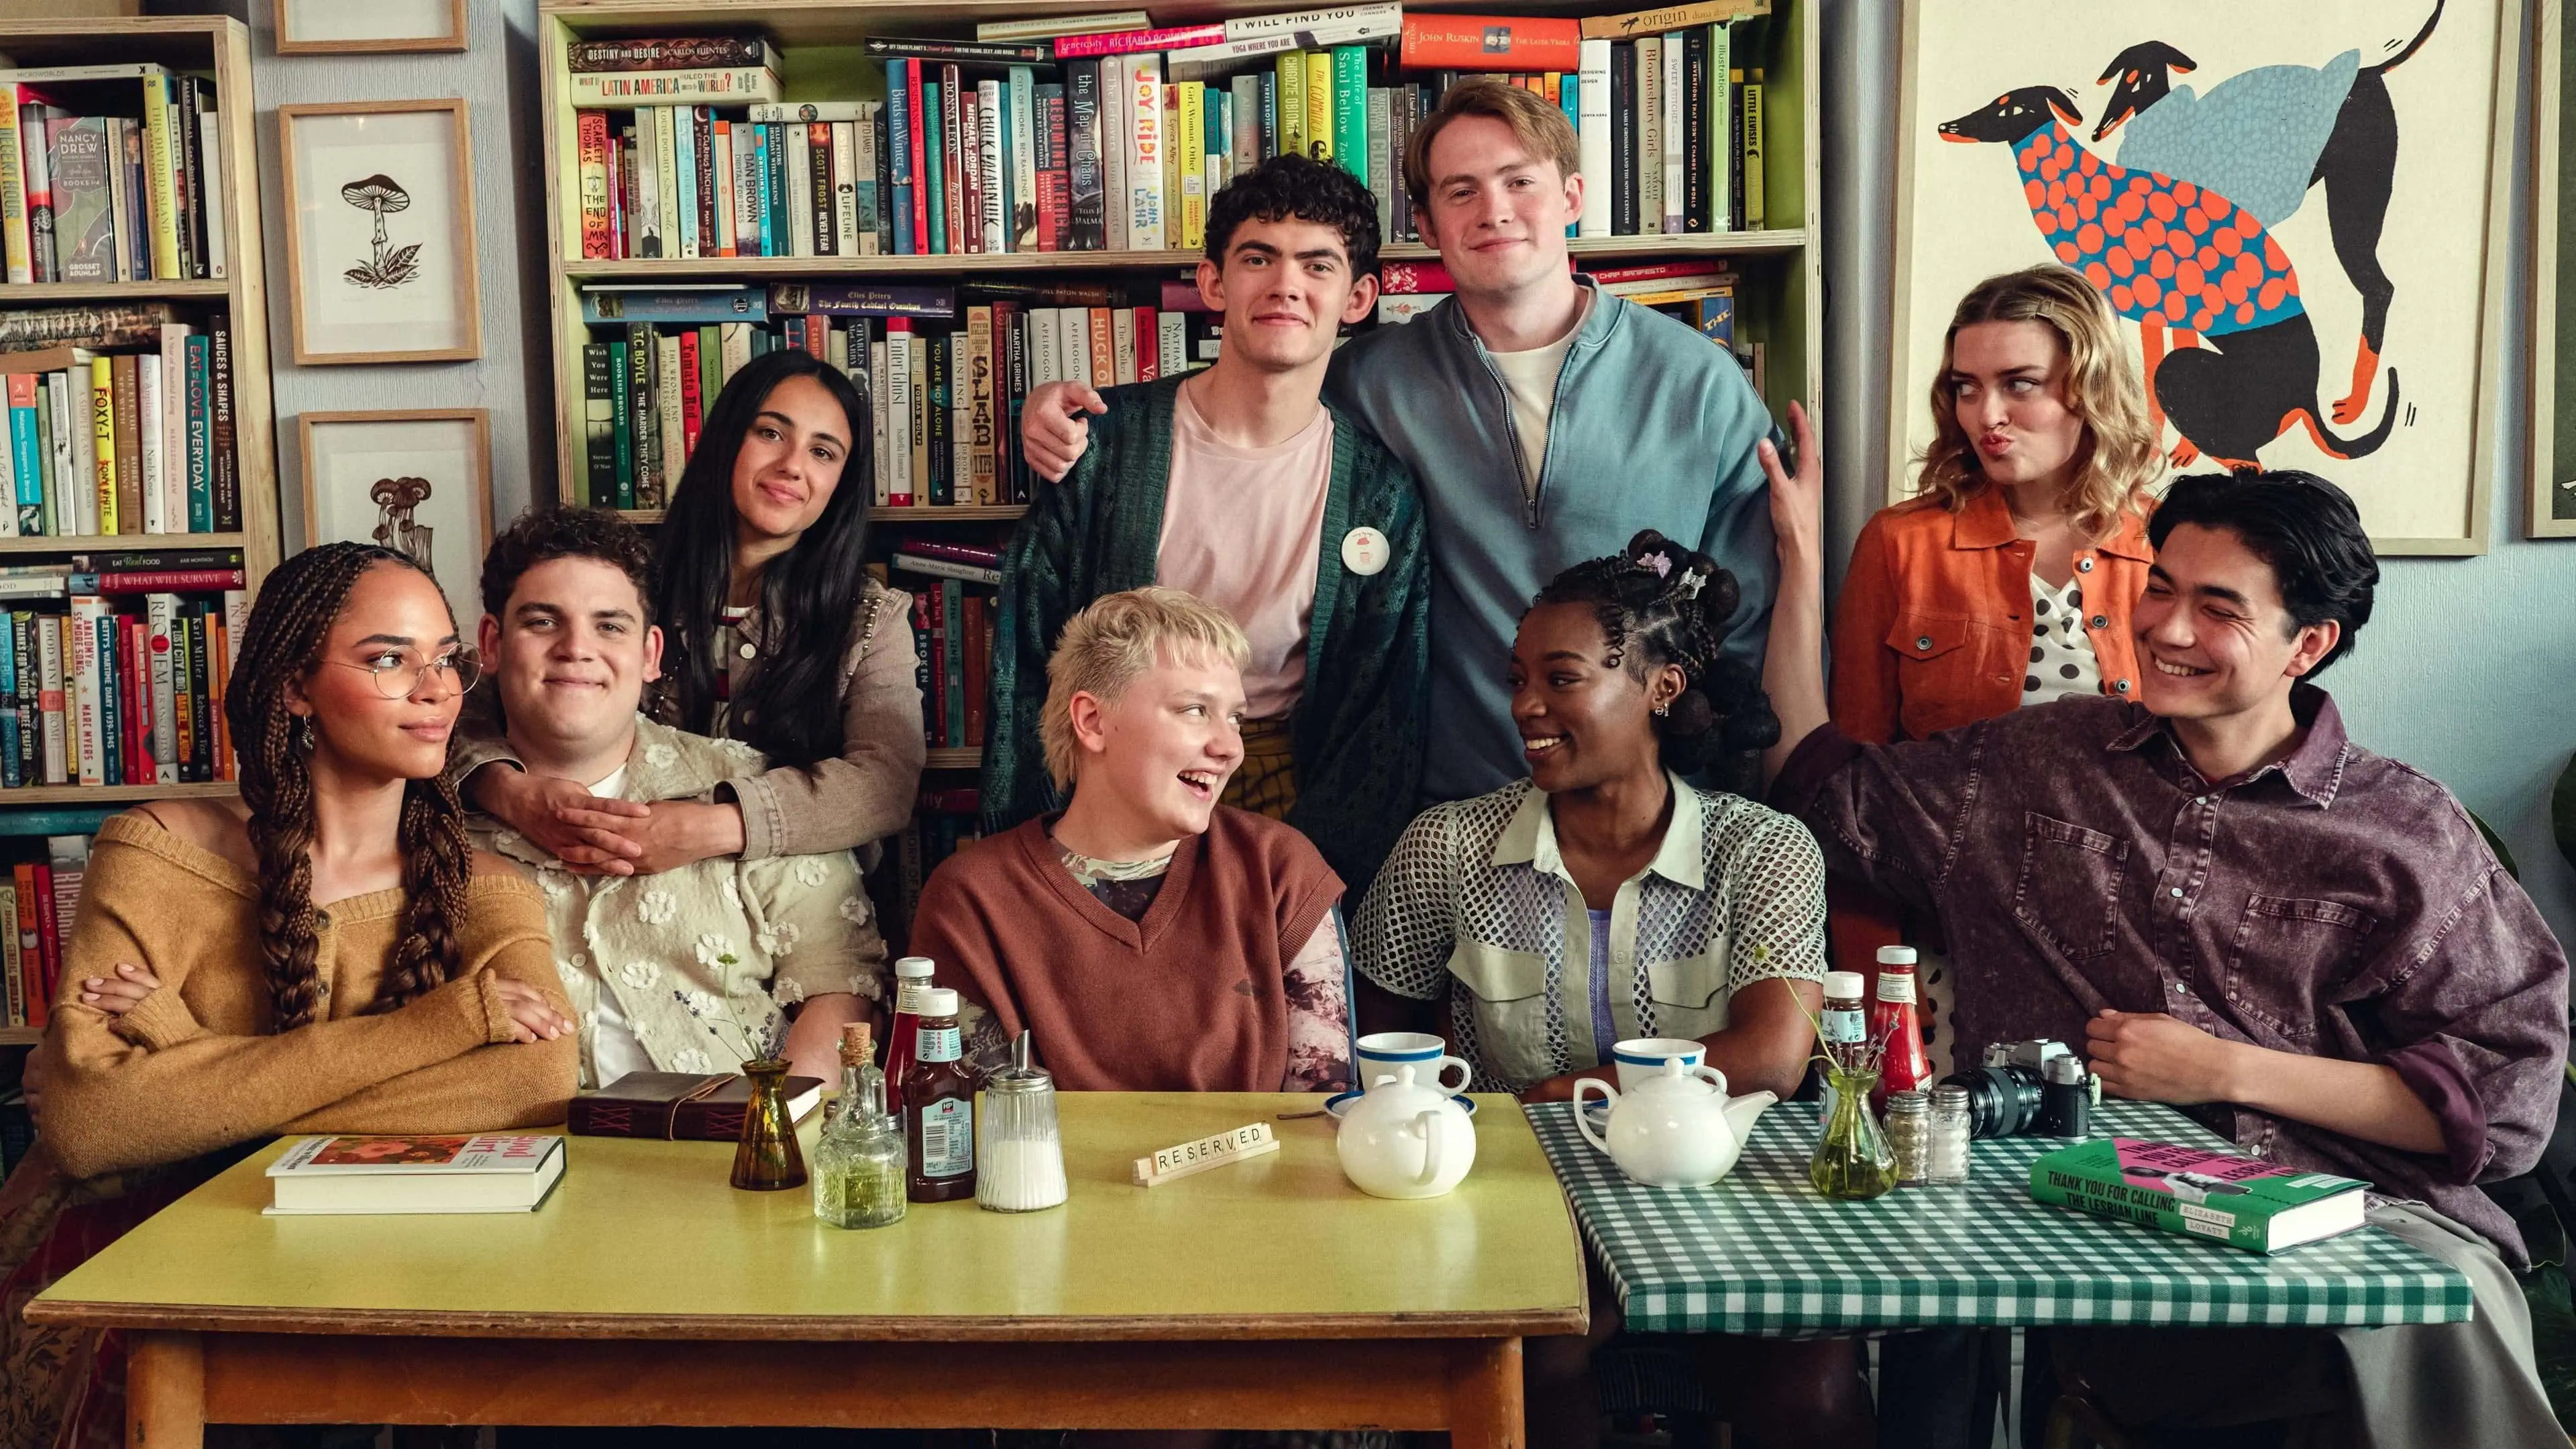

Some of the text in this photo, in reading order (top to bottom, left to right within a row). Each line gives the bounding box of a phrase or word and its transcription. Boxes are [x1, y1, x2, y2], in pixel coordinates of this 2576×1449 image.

[1235, 10, 1354, 30] I WILL FIND YOU
[1644, 11, 1686, 27] origin
[588, 47, 659, 60] DESTINY AND DESIRE
[1232, 39, 1290, 54] YOGA WHERE YOU ARE
[1419, 33, 1479, 44] JOHN RUSKIN
[602, 80, 631, 97] LATIN
[634, 78, 680, 95] AMERICA
[1285, 57, 1298, 95] CHIGOZIE
[1354, 52, 1362, 105] The Life of
[1717, 45, 1725, 97] illustration
[1338, 52, 1350, 134] Saul Bellow
[1645, 49, 1658, 158] Bloomsbury Girls
[892, 89, 906, 168] Birds in Winter
[945, 81, 957, 154] DONNA LEON
[1075, 101, 1093, 127] Map
[1187, 109, 1195, 144] Woman,
[1748, 90, 1757, 146] LITTLE ELVISES
[60, 134, 96, 143] NANCY
[61, 144, 97, 154] DREW
[582, 123, 592, 163] THOMAS
[593, 118, 602, 164] SCARLETT
[967, 104, 979, 190] MICHAEL JORDAN
[1016, 75, 1028, 198] CITY OF THORNS BEN RAWLENCE
[1079, 134, 1095, 144] of
[152, 106, 170, 234] THIS DIVIDED ISLAND
[1075, 150, 1095, 186] Chaos
[1188, 146, 1196, 171] Other
[584, 195, 605, 203] THE
[744, 153, 757, 223] DAN BROWN
[815, 148, 829, 251] SCOTT FROST NEVER FEAR
[32, 217, 40, 235] TOM
[586, 207, 606, 217] END
[589, 221, 603, 229] OF
[842, 196, 853, 240] LIFELINE
[1134, 189, 1146, 228] LAHR
[1146, 192, 1159, 225] JOHN
[1705, 310, 1731, 330] THE
[190, 345, 201, 370] EAT
[216, 331, 227, 369] SAUCES
[634, 347, 645, 384] BOYLE
[1013, 329, 1022, 393] MARTHA GRIMES
[1041, 323, 1050, 381] APEIROGON
[1071, 322, 1079, 381] APEIROGON
[890, 338, 906, 405] Enter Ghost
[955, 339, 963, 407] COUNTING
[191, 380, 203, 417] LOVE
[217, 384, 229, 421] SHAPES
[973, 356, 990, 446] SLAB
[639, 409, 647, 441] HARDER
[914, 421, 922, 445] WOLFF
[934, 406, 943, 437] ALONE
[95, 388, 109, 441] FOXY-T
[102, 488, 111, 517] WHITE
[192, 421, 204, 492] EVERYDAY
[641, 464, 649, 488] COME
[123, 576, 154, 585] WHAT
[156, 575, 178, 584] WILL
[46, 623, 55, 655] FOOD
[151, 600, 170, 685] REQUIEM
[193, 618, 203, 640] Karl
[103, 651, 112, 684] WARTIME
[174, 649, 185, 668] CITY
[195, 645, 204, 679] Miller
[919, 634, 928, 683] BROKEN
[105, 687, 113, 708] DIARY
[1159, 1128, 1262, 1171] RESERVED
[2047, 1171, 2176, 1213] THANK YOU FOR CALLING
[2065, 1192, 2158, 1225] THE LESBIAN LINE
